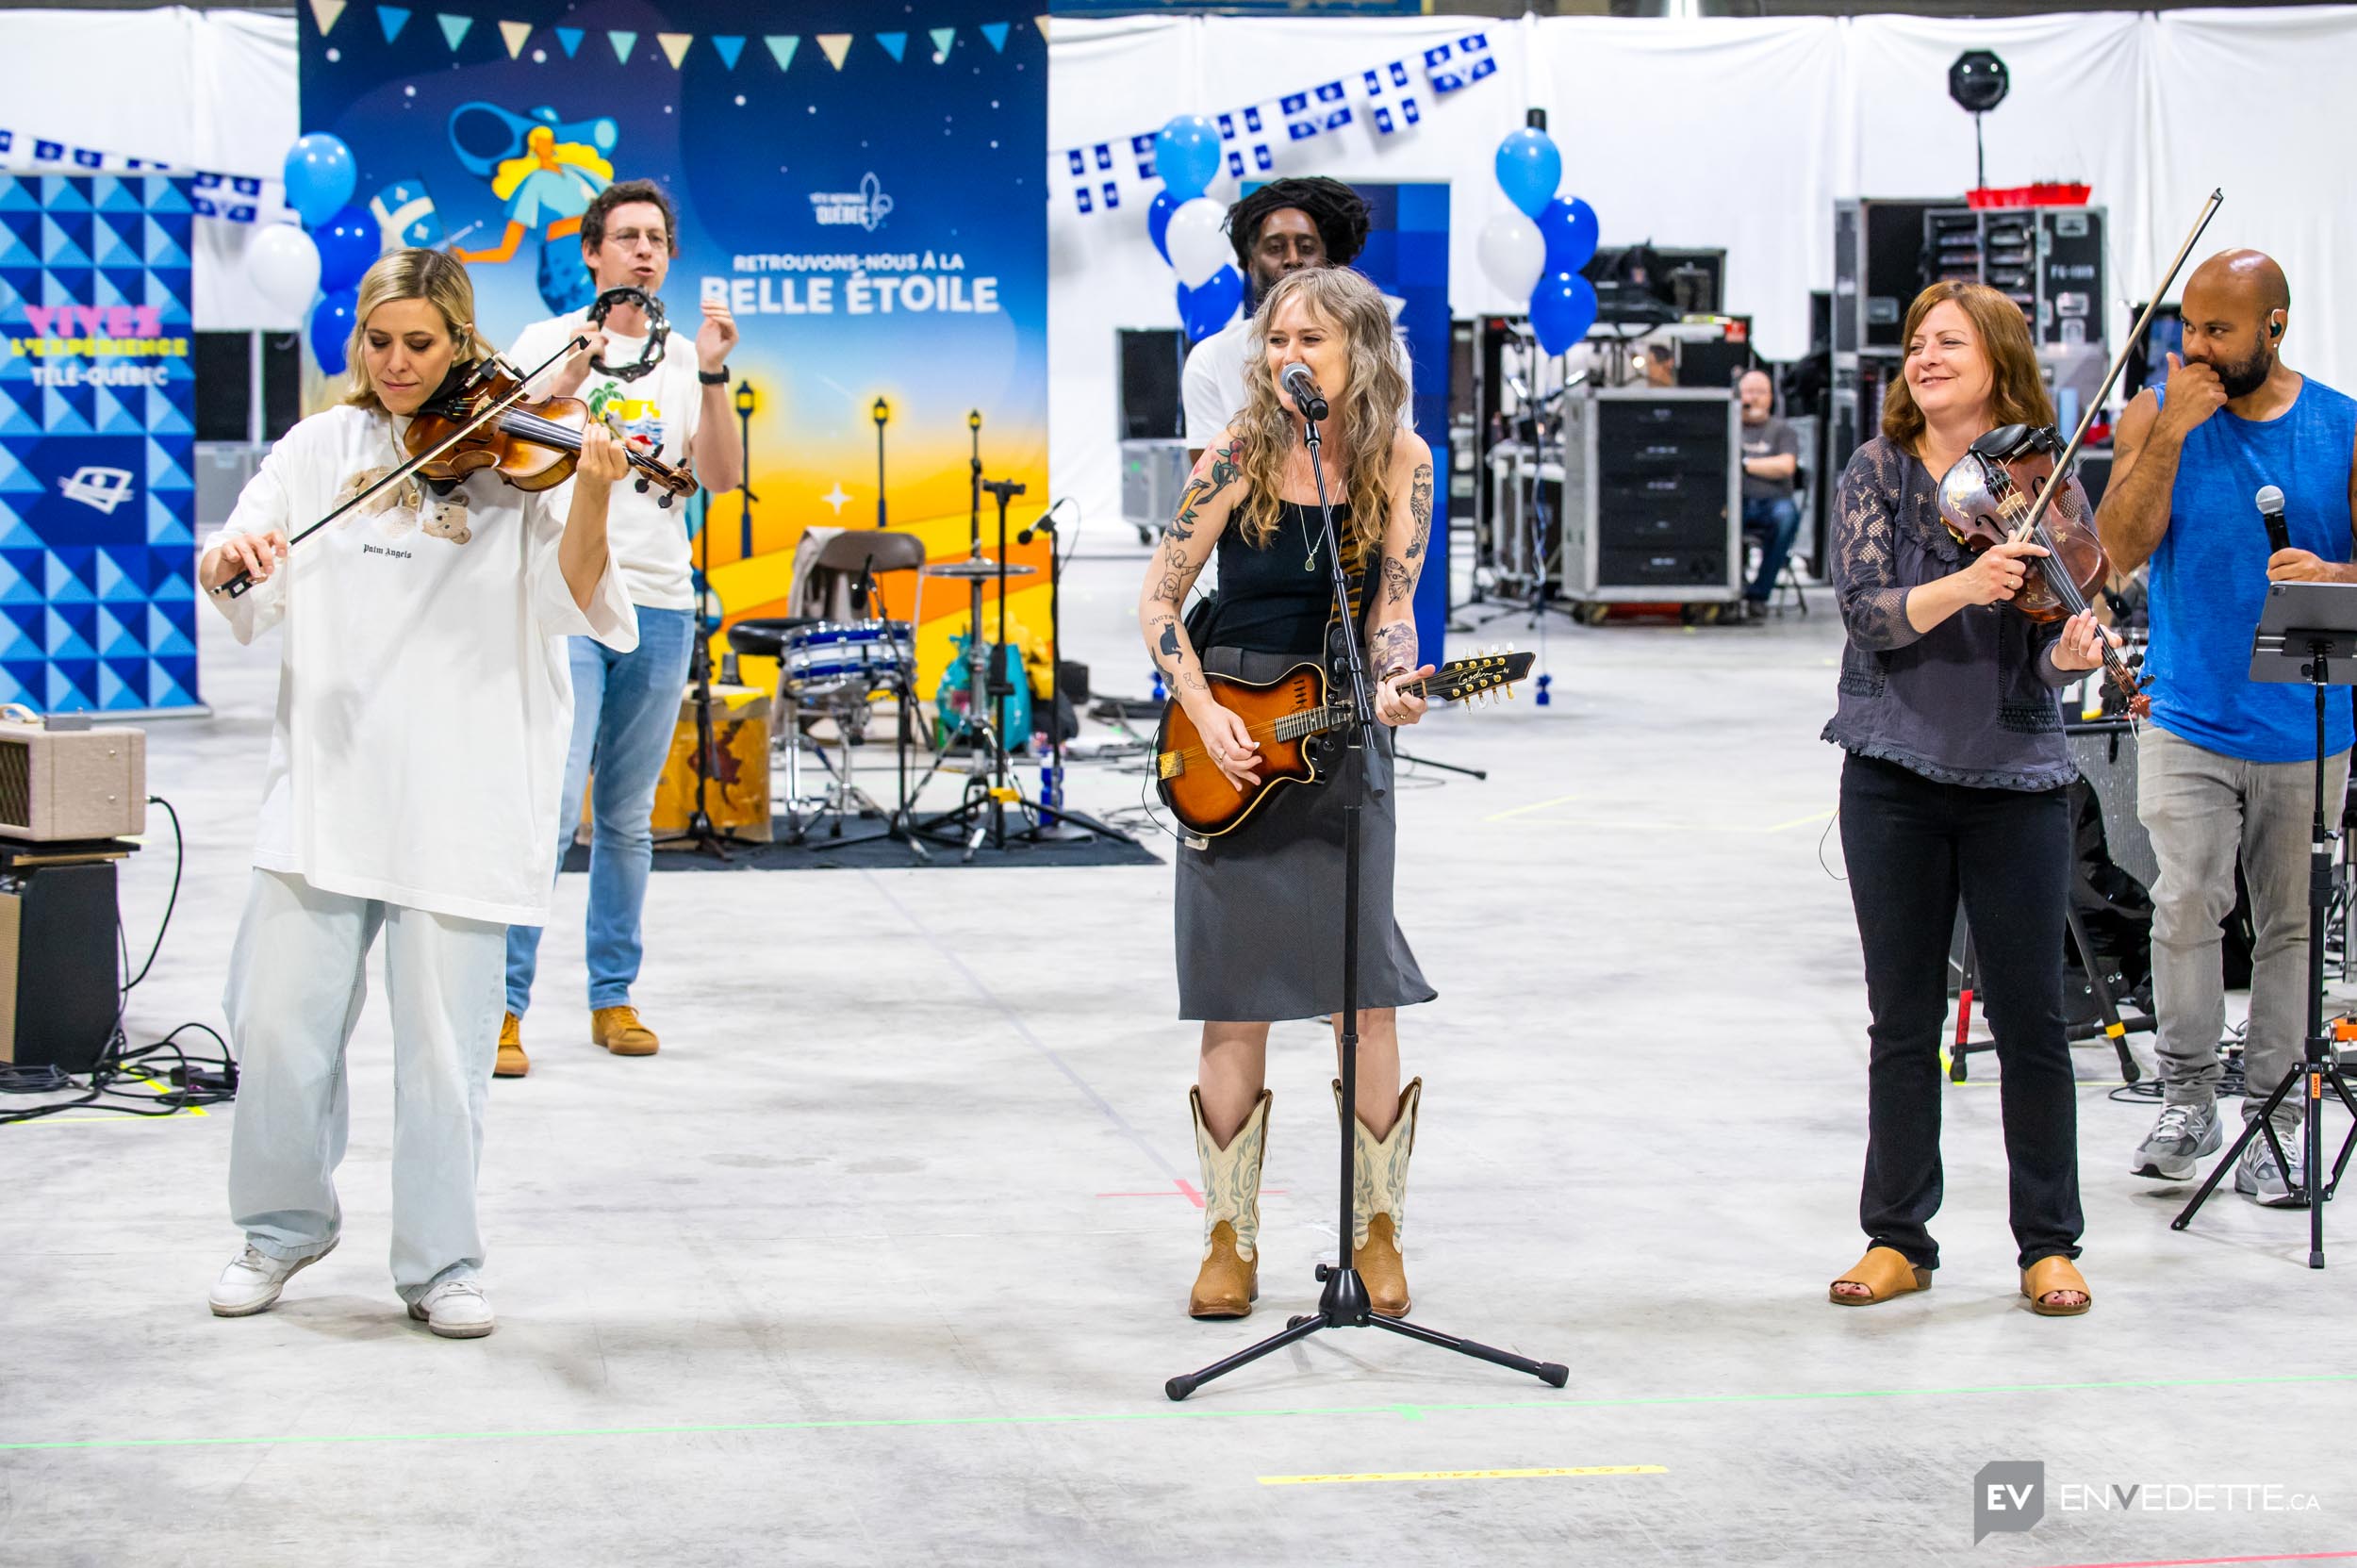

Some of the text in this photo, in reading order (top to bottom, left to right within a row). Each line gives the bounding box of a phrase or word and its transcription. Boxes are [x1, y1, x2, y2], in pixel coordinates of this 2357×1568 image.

[733, 250, 964, 271] RETROUVONS-NOUS À LA
[701, 270, 999, 314] BELLE ÉTOILE
[24, 305, 162, 338] VIVEZ
[31, 362, 169, 387] TÉLÉ-QUÉBEC
[364, 544, 411, 558] Palm Angels
[1459, 668, 1492, 685] Godin
